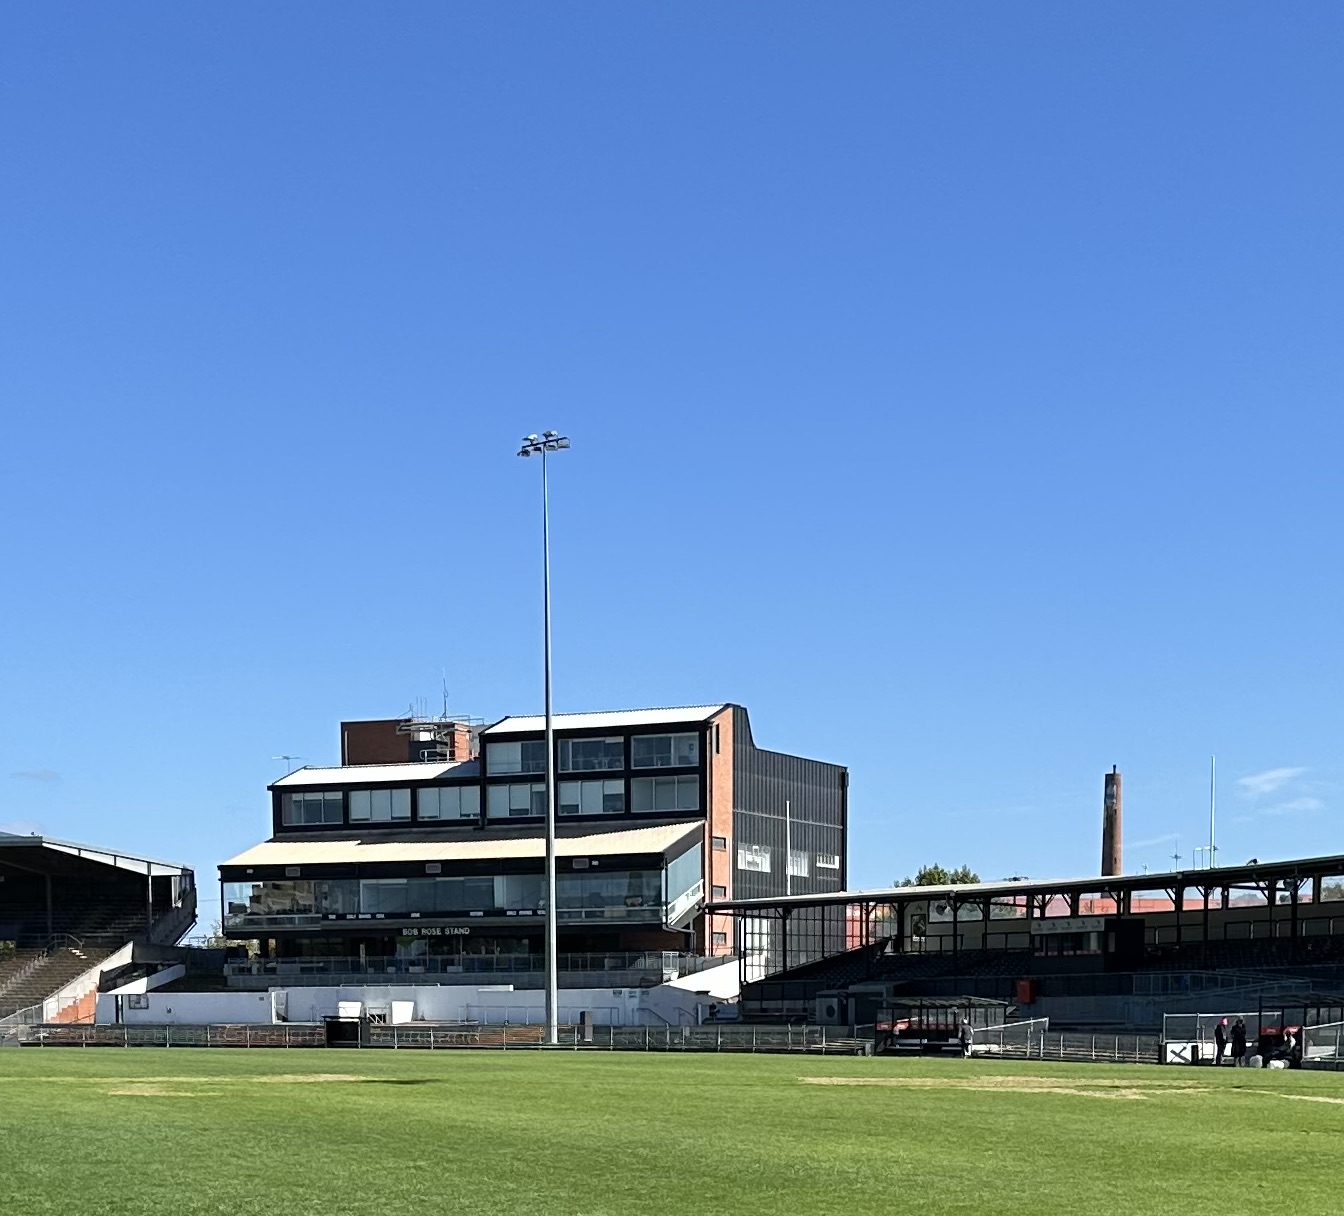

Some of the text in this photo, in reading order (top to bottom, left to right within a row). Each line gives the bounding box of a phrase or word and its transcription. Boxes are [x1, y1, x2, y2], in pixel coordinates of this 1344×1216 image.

[402, 927, 471, 936] BOB ROSE STAND
